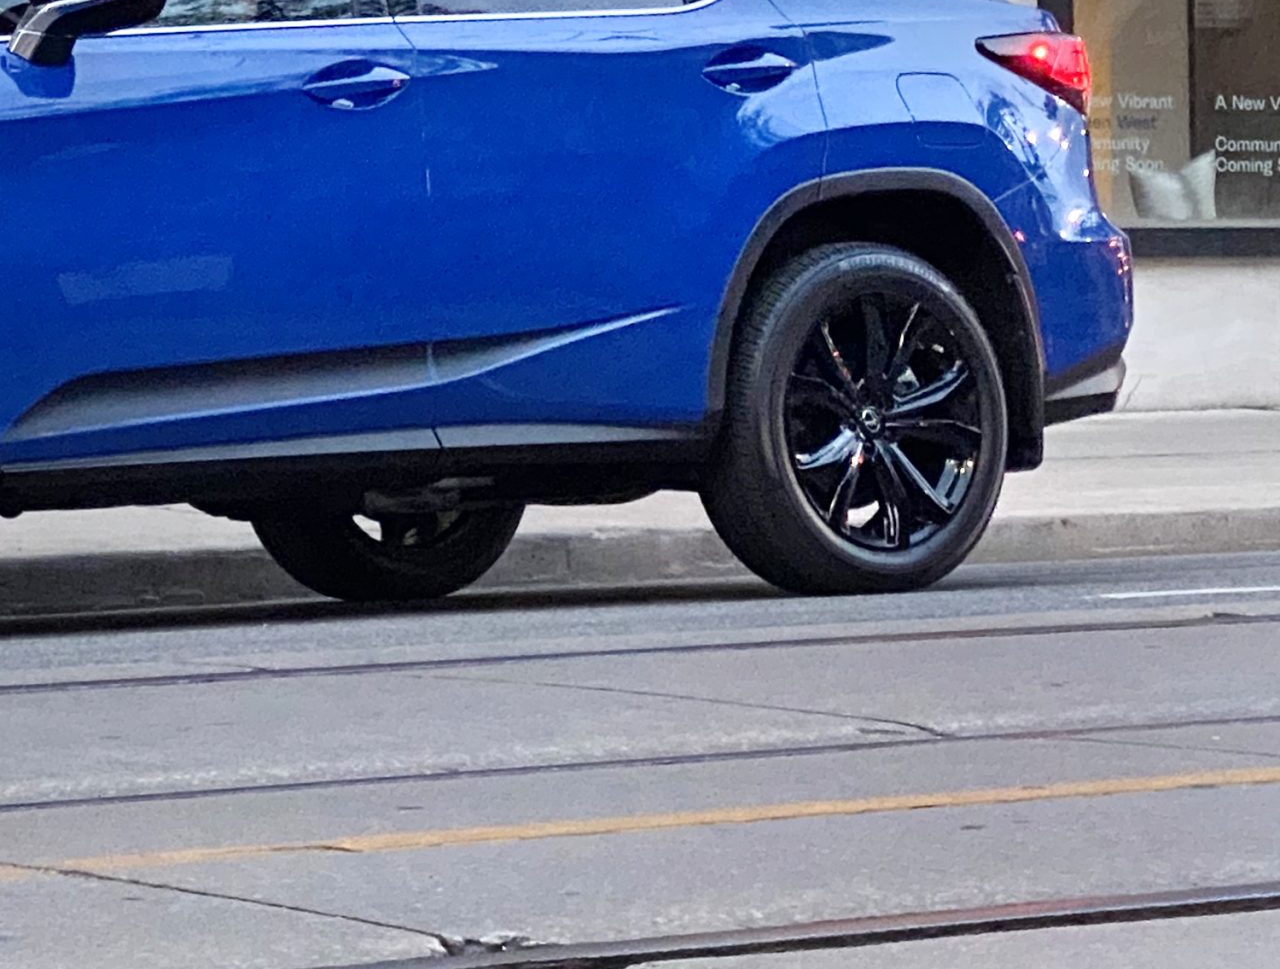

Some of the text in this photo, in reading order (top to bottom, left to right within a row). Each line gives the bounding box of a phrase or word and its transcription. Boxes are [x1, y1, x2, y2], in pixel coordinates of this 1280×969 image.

[1117, 93, 1174, 110] Vibrant
[1215, 94, 1227, 110] A
[1232, 94, 1265, 111] New
[1125, 155, 1165, 172] Soon
[1216, 156, 1273, 177] Coming
